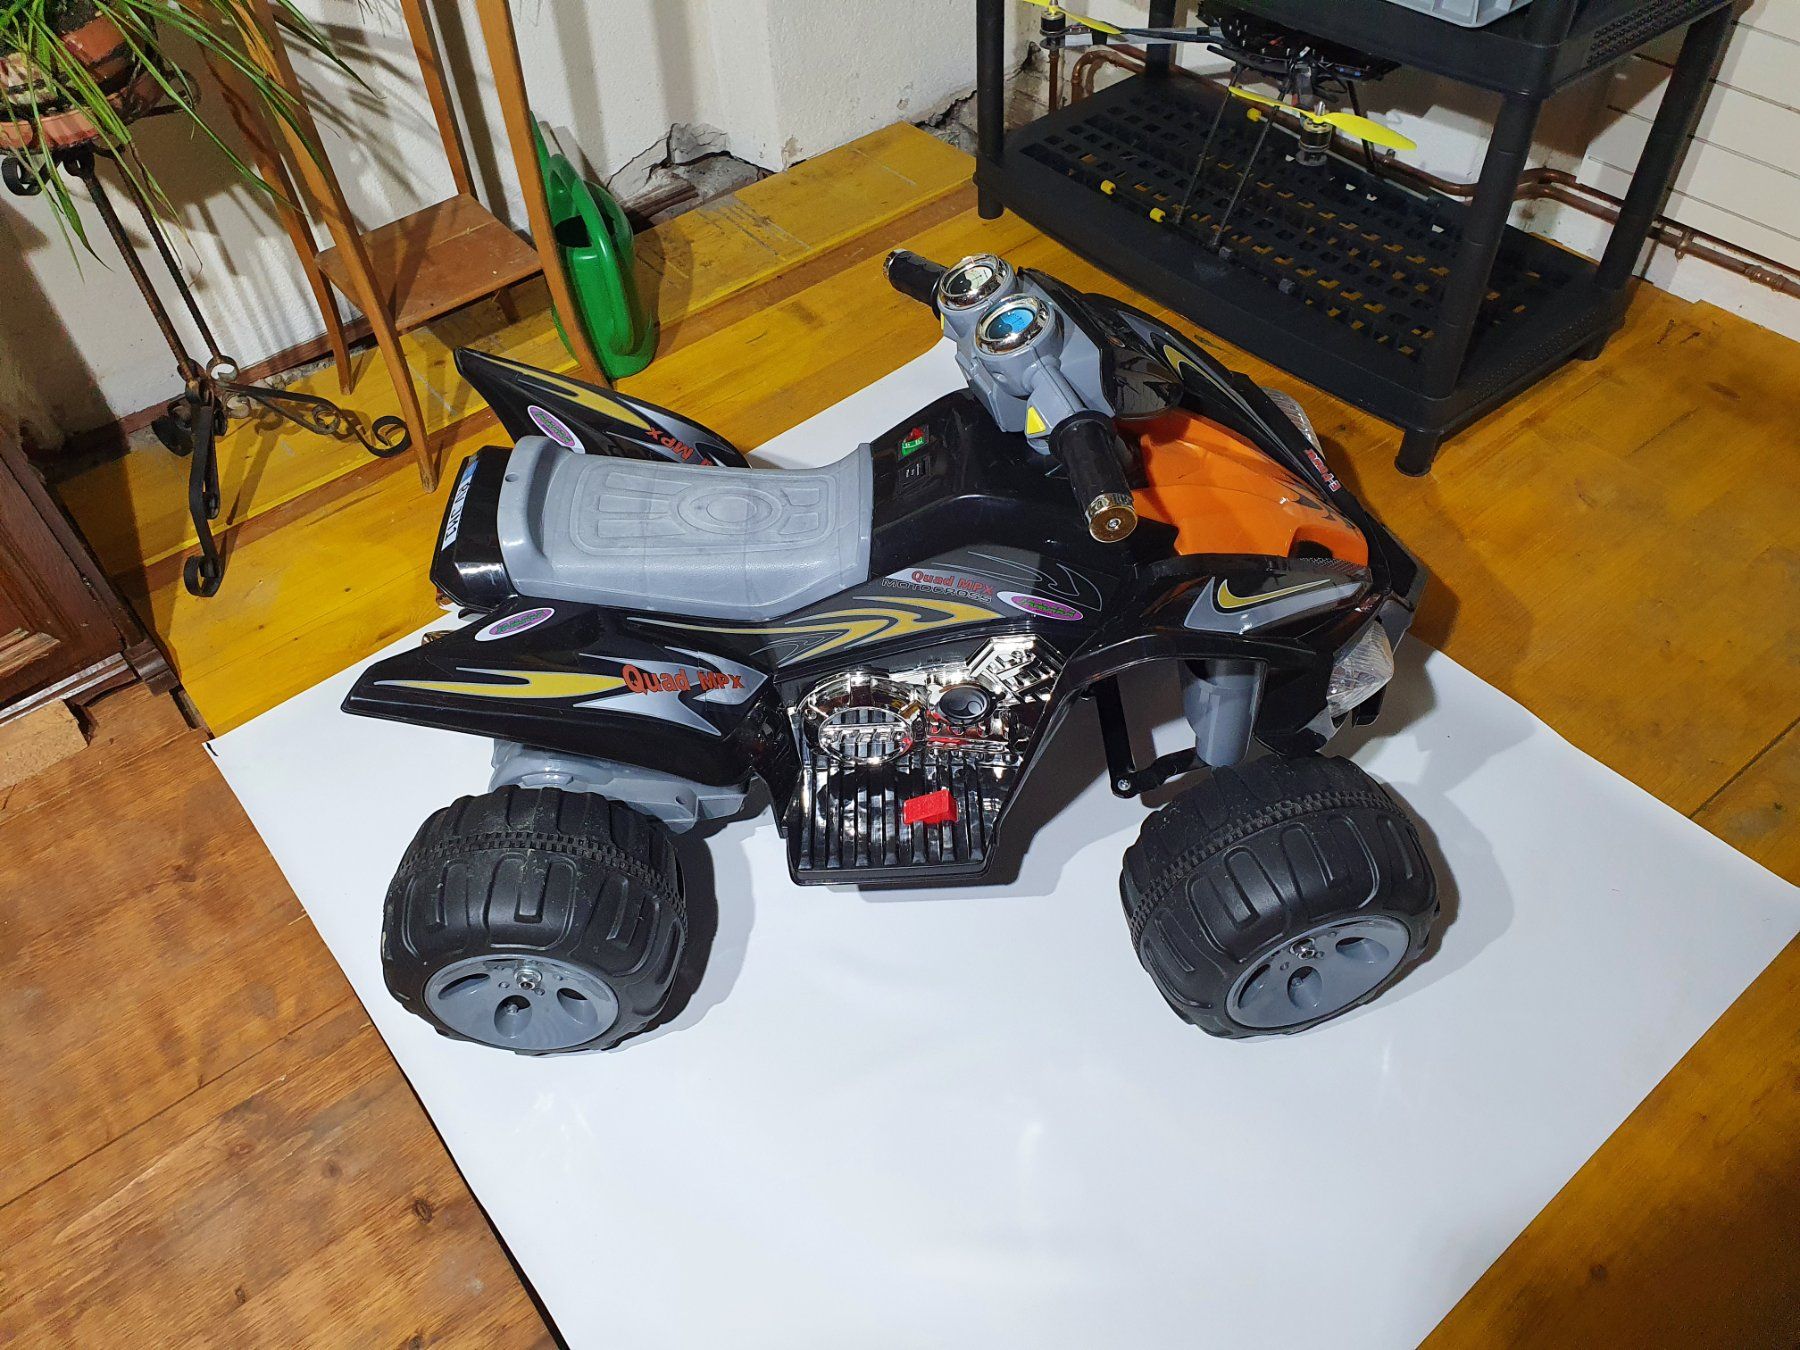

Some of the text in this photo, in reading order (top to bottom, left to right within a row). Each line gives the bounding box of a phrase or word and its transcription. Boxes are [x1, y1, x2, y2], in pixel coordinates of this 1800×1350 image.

[645, 427, 694, 461] MPX
[911, 569, 994, 595] Quad MPX
[622, 663, 745, 695] Quad MPX
